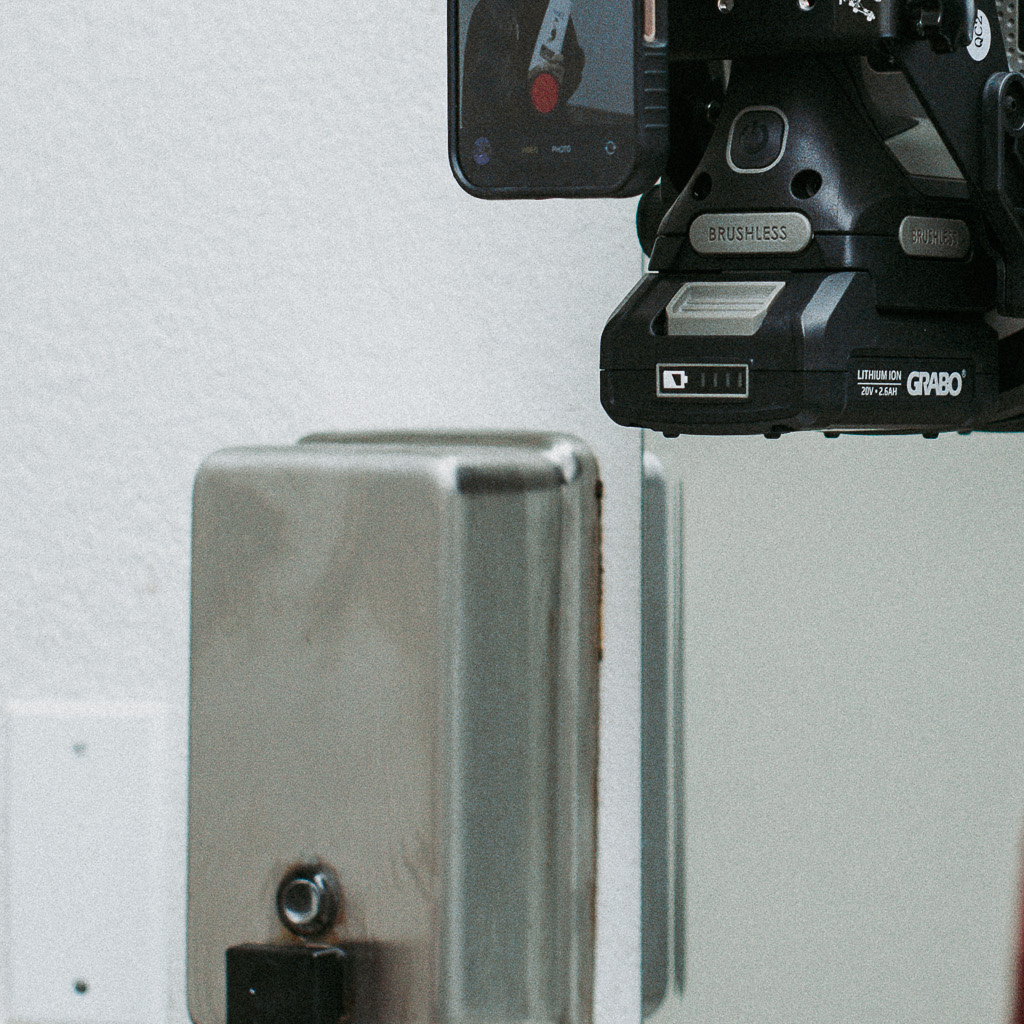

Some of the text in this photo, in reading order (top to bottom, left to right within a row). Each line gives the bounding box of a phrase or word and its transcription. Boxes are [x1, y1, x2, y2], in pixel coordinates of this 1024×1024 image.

[974, 14, 985, 48] QC2
[708, 225, 788, 243] BRUSHLESS
[857, 369, 902, 381] LITHIUM ION
[906, 370, 963, 397] GRABO
